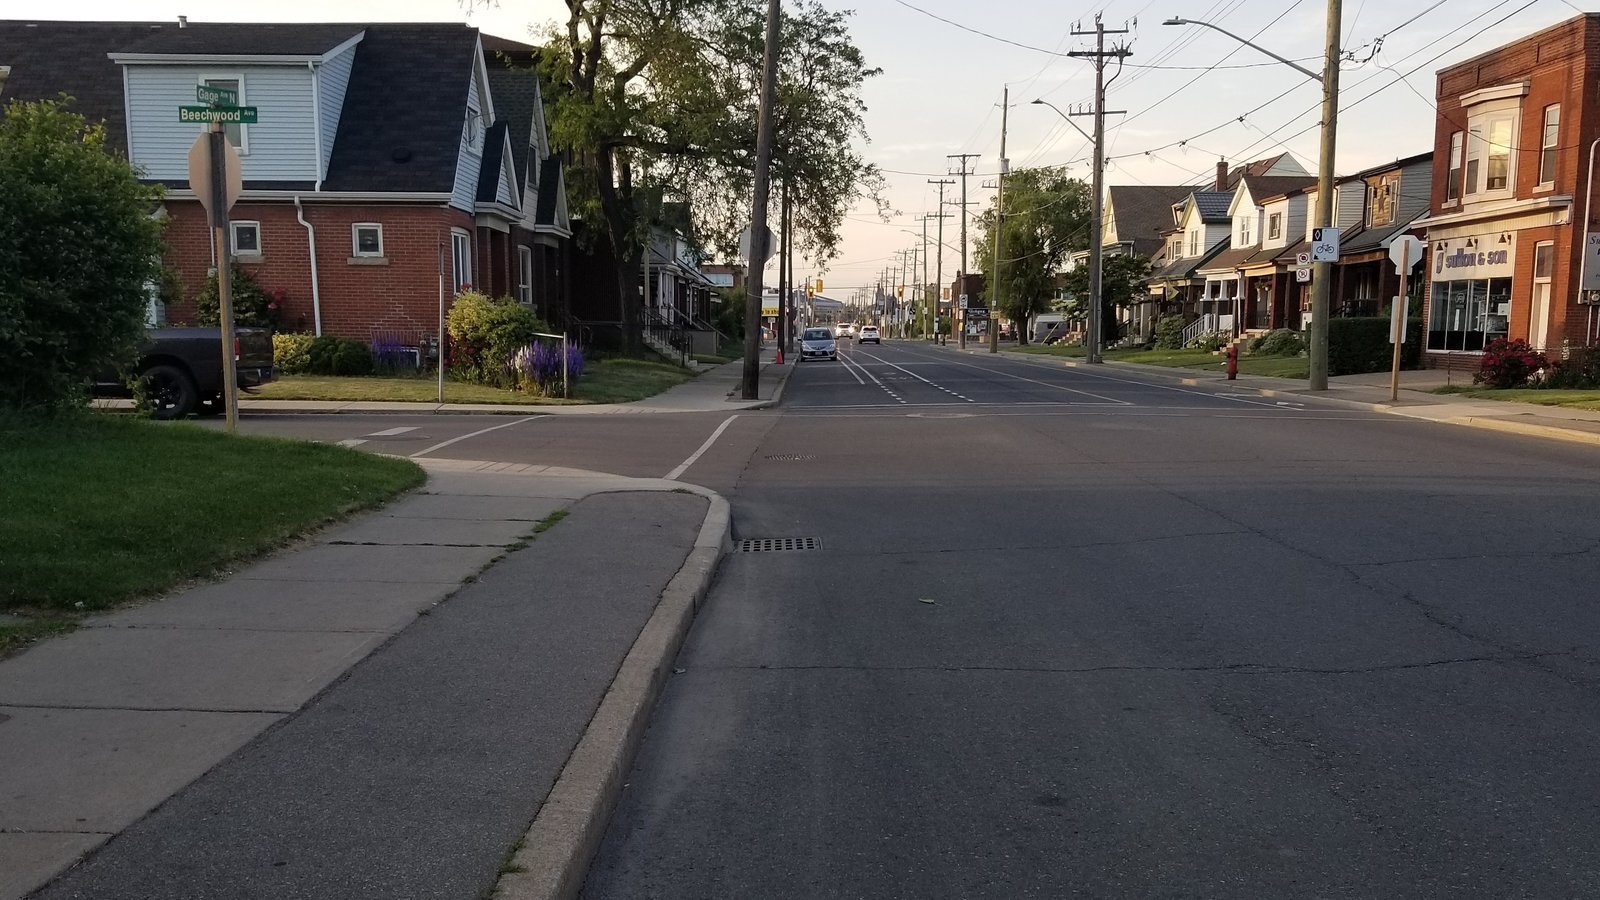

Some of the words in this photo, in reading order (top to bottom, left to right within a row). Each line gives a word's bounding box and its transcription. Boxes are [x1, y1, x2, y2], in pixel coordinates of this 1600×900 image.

[198, 88, 219, 104] Gage
[229, 92, 236, 104] N
[181, 108, 240, 121] Beechwood
[1445, 248, 1476, 268] sutton
[1477, 252, 1485, 266] &
[1487, 250, 1507, 266] son
